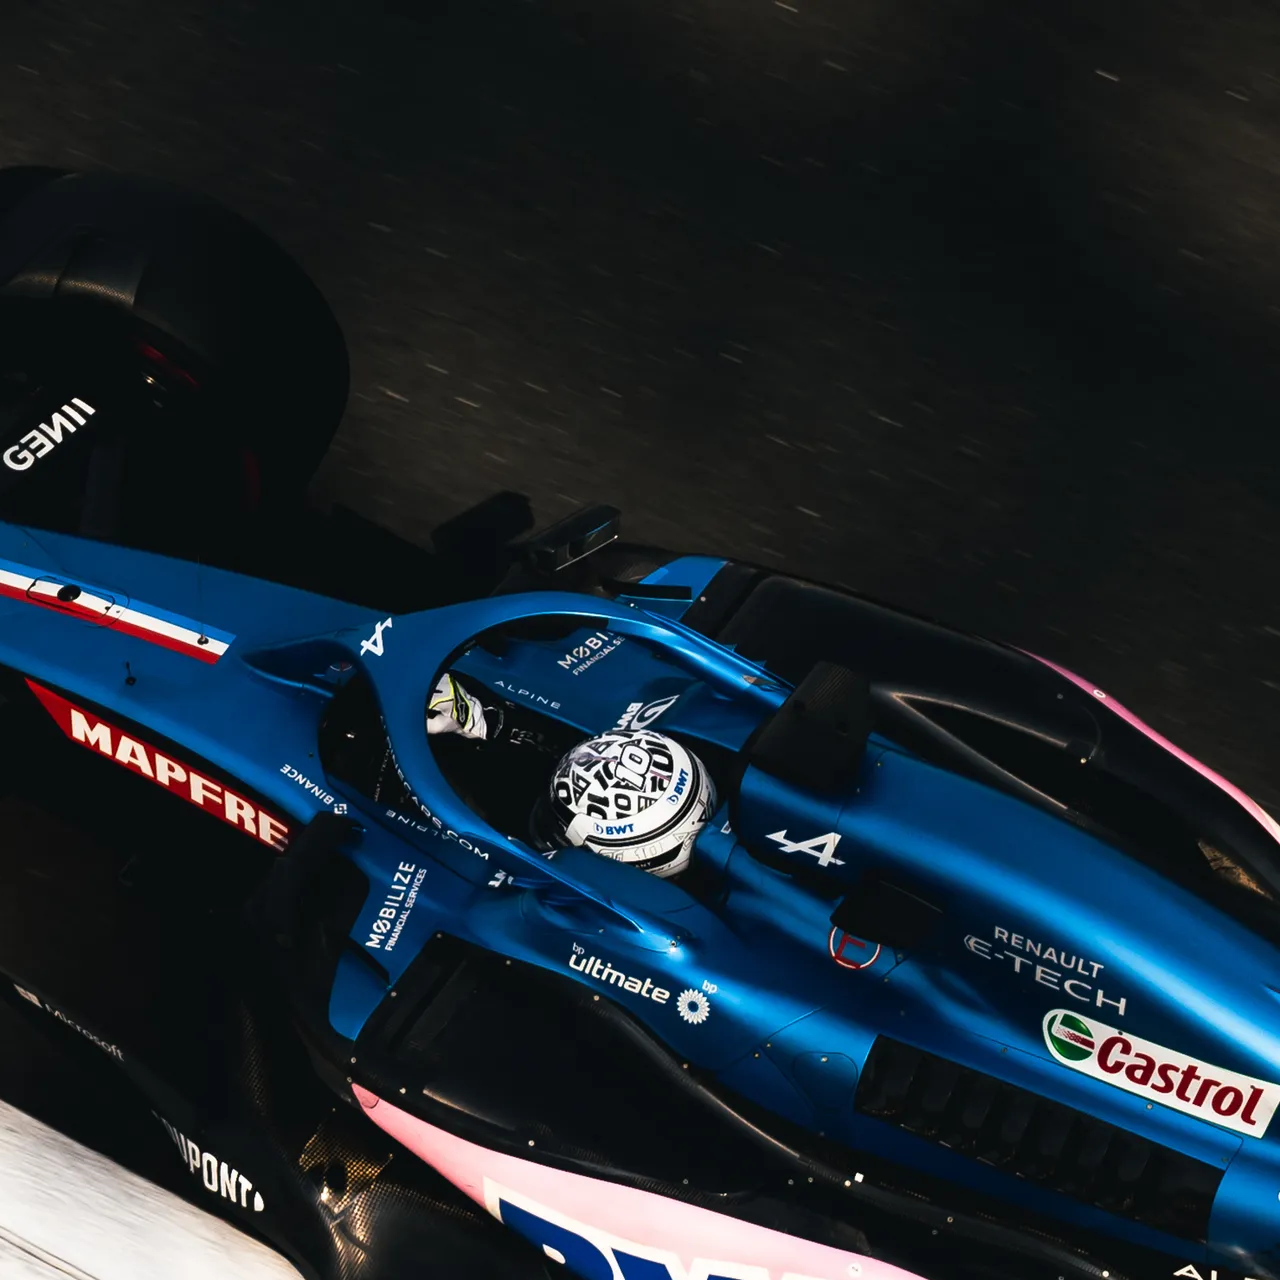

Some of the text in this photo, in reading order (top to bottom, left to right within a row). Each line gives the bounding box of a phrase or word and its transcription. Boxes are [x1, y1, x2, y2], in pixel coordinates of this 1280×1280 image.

[494, 680, 561, 709] ALPINE
[70, 708, 289, 853] MAPFRE
[281, 763, 335, 806] BINANCE
[614, 742, 653, 794] 10
[673, 768, 690, 796] BWT
[605, 823, 634, 835] BWT
[384, 868, 427, 951] FINANCIAL SERVICES
[572, 941, 586, 957] bp
[994, 925, 1105, 979] RENAULT
[569, 954, 671, 1004] ultimate
[701, 979, 718, 995] bp
[45, 1003, 125, 1062] Microsoft
[1096, 1035, 1264, 1126] Castrol
